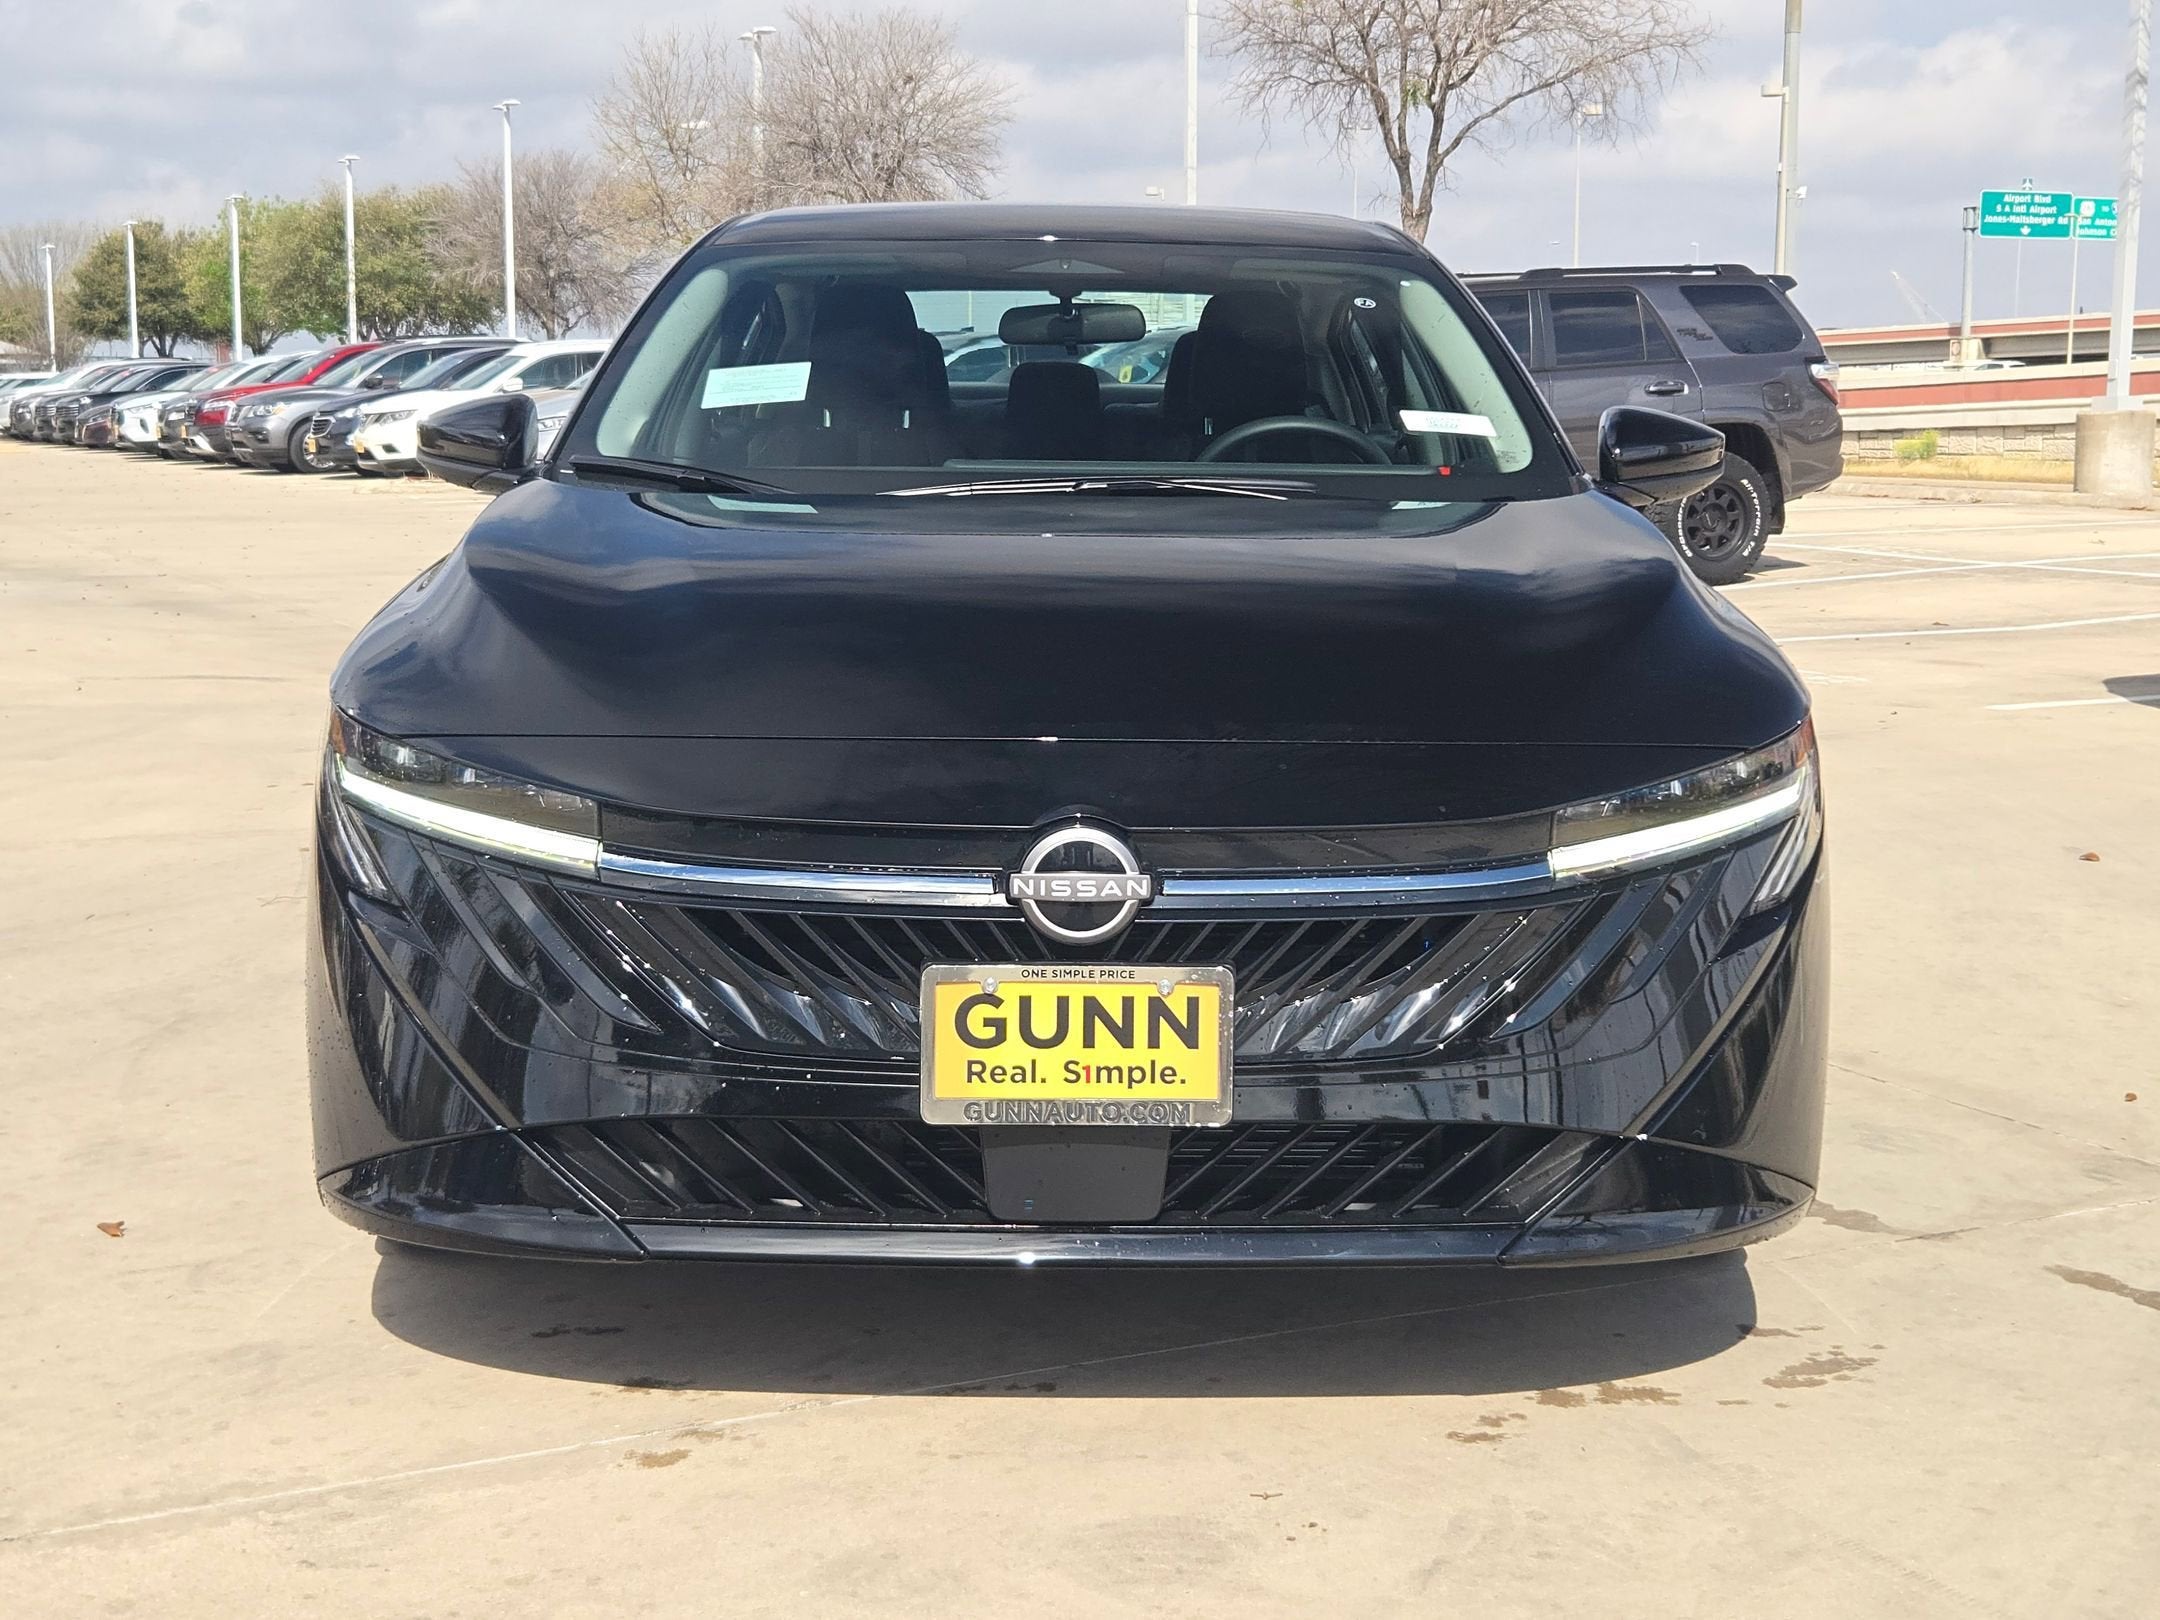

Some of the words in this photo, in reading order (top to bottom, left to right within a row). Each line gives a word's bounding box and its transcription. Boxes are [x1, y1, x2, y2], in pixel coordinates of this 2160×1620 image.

[2003, 193, 2031, 204] Airport
[2034, 194, 2052, 203] Blvd
[2004, 204, 2011, 213] A
[2013, 204, 2027, 213] Intl
[2029, 205, 2058, 215] Airport
[1984, 214, 2056, 226] Jones-Maltsberger
[2057, 216, 2069, 225] Rd
[1012, 876, 1150, 898] NISSAN
[1021, 969, 1048, 979] ONE
[1051, 969, 1096, 979] SIMPLE
[1099, 969, 1136, 979] PRICE
[954, 993, 1200, 1050] GUNN
[966, 1059, 1047, 1084] Real.
[963, 1101, 1192, 1123] GUNNAUTO.COM
